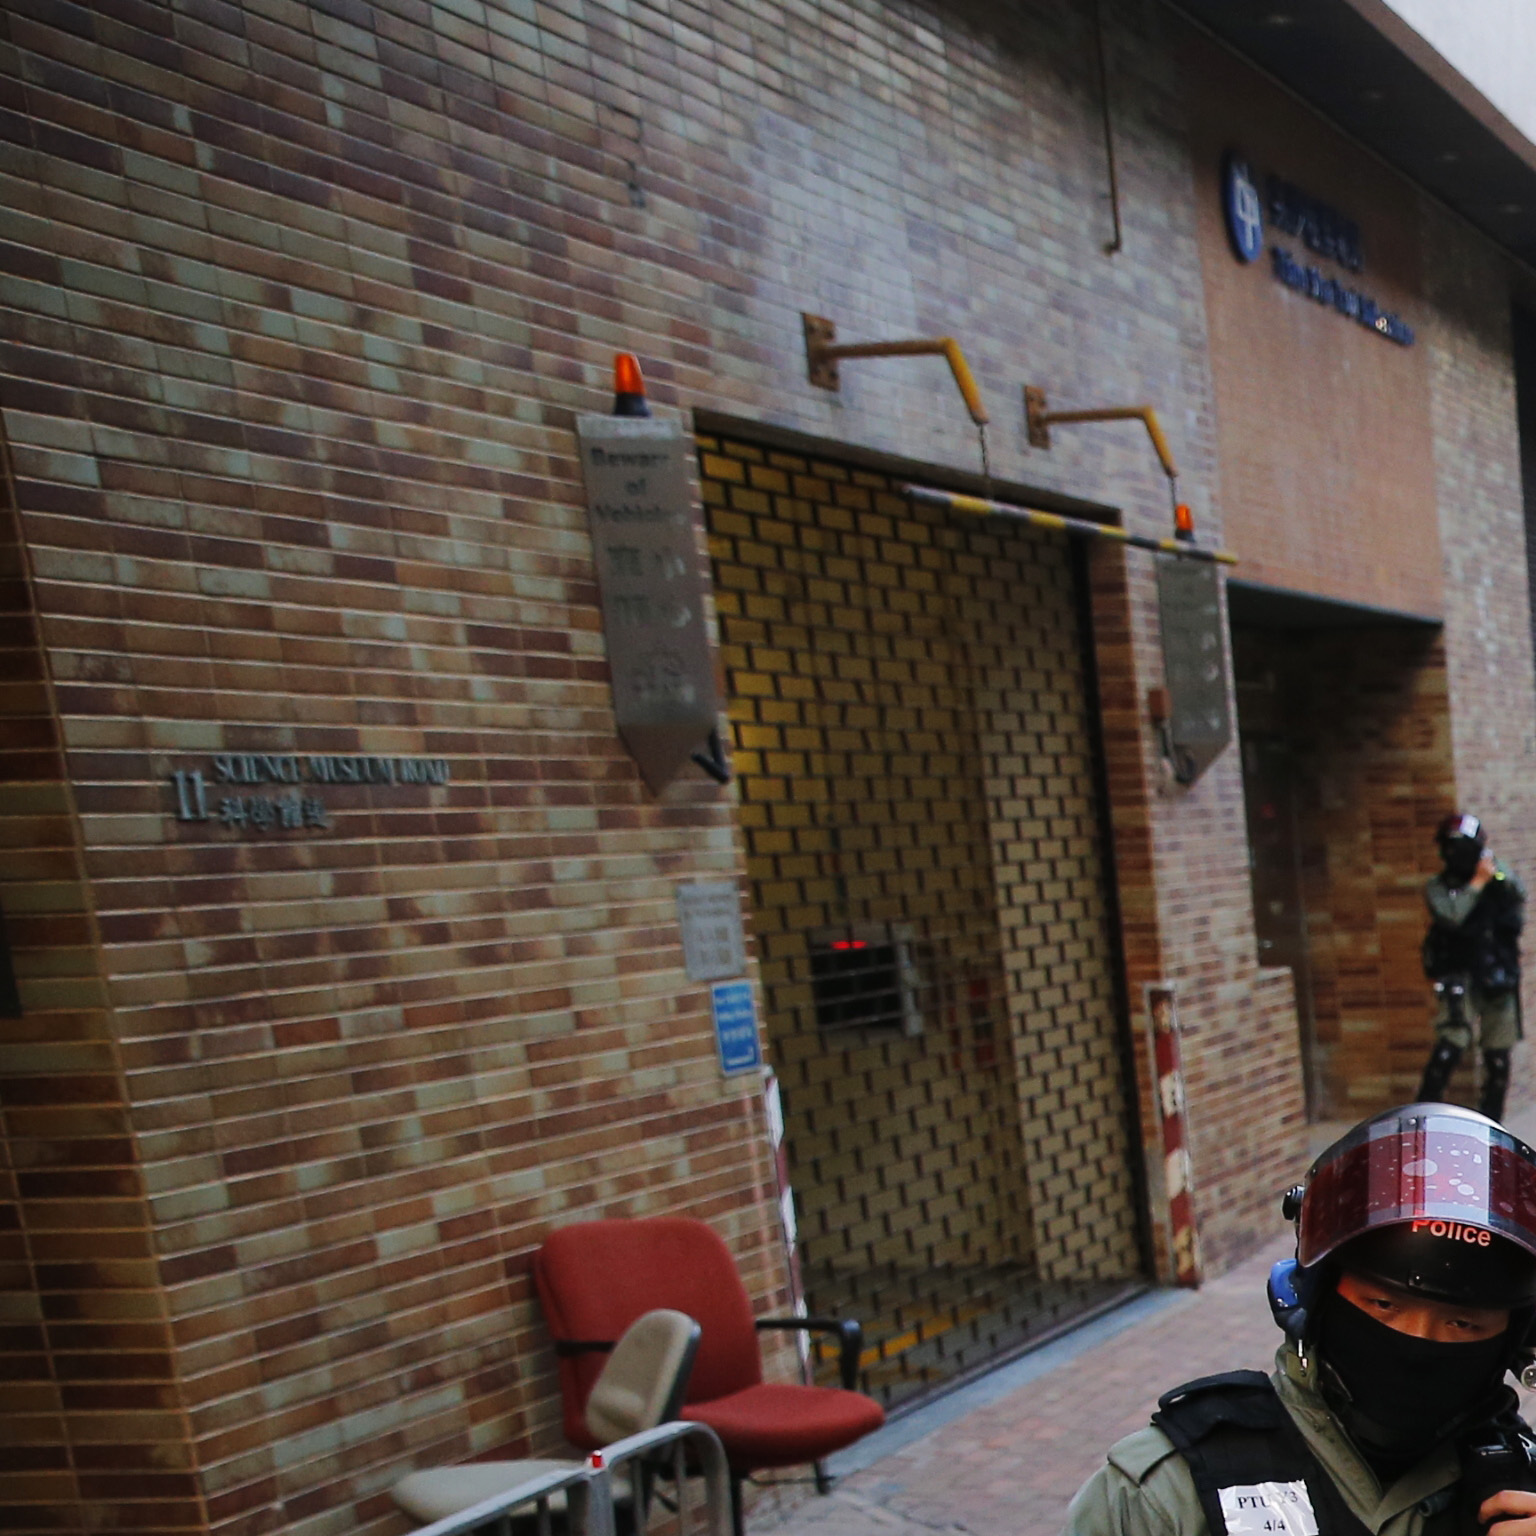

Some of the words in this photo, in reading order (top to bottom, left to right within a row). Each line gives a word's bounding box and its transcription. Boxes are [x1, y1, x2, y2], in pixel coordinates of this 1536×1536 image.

[172, 769, 208, 820] 11
[215, 755, 300, 783] SCIENCE
[308, 757, 396, 785] MUSEUM
[1412, 1209, 1491, 1247] Police
[1237, 1493, 1272, 1509] PTU
[1263, 1519, 1286, 1532] 4/4
